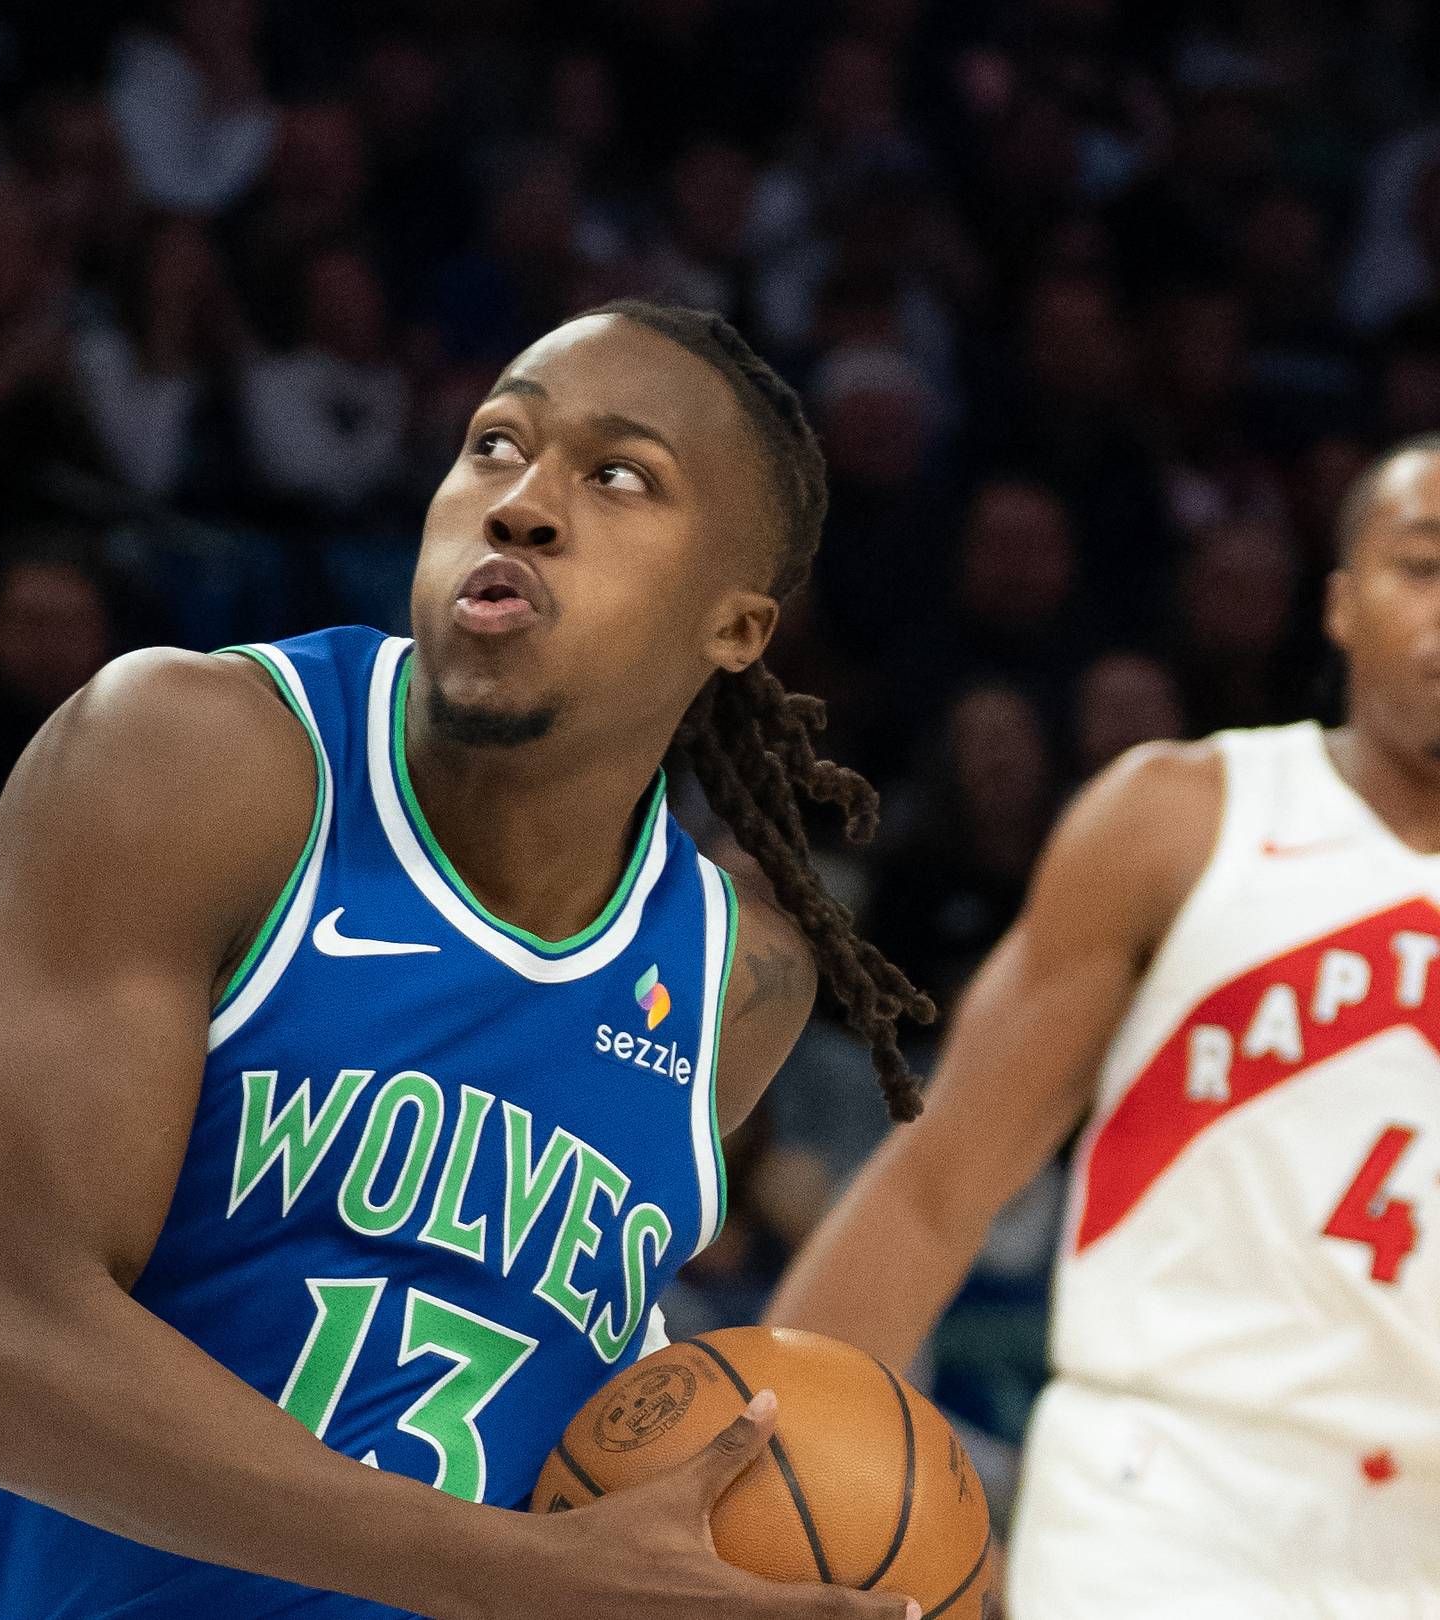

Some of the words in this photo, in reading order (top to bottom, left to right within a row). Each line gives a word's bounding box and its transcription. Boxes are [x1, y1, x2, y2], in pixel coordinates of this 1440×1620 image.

[595, 1024, 692, 1085] sezzle
[227, 1069, 672, 1365] WOLVES
[1321, 1123, 1440, 1284] 4
[277, 1277, 539, 1504] 13
